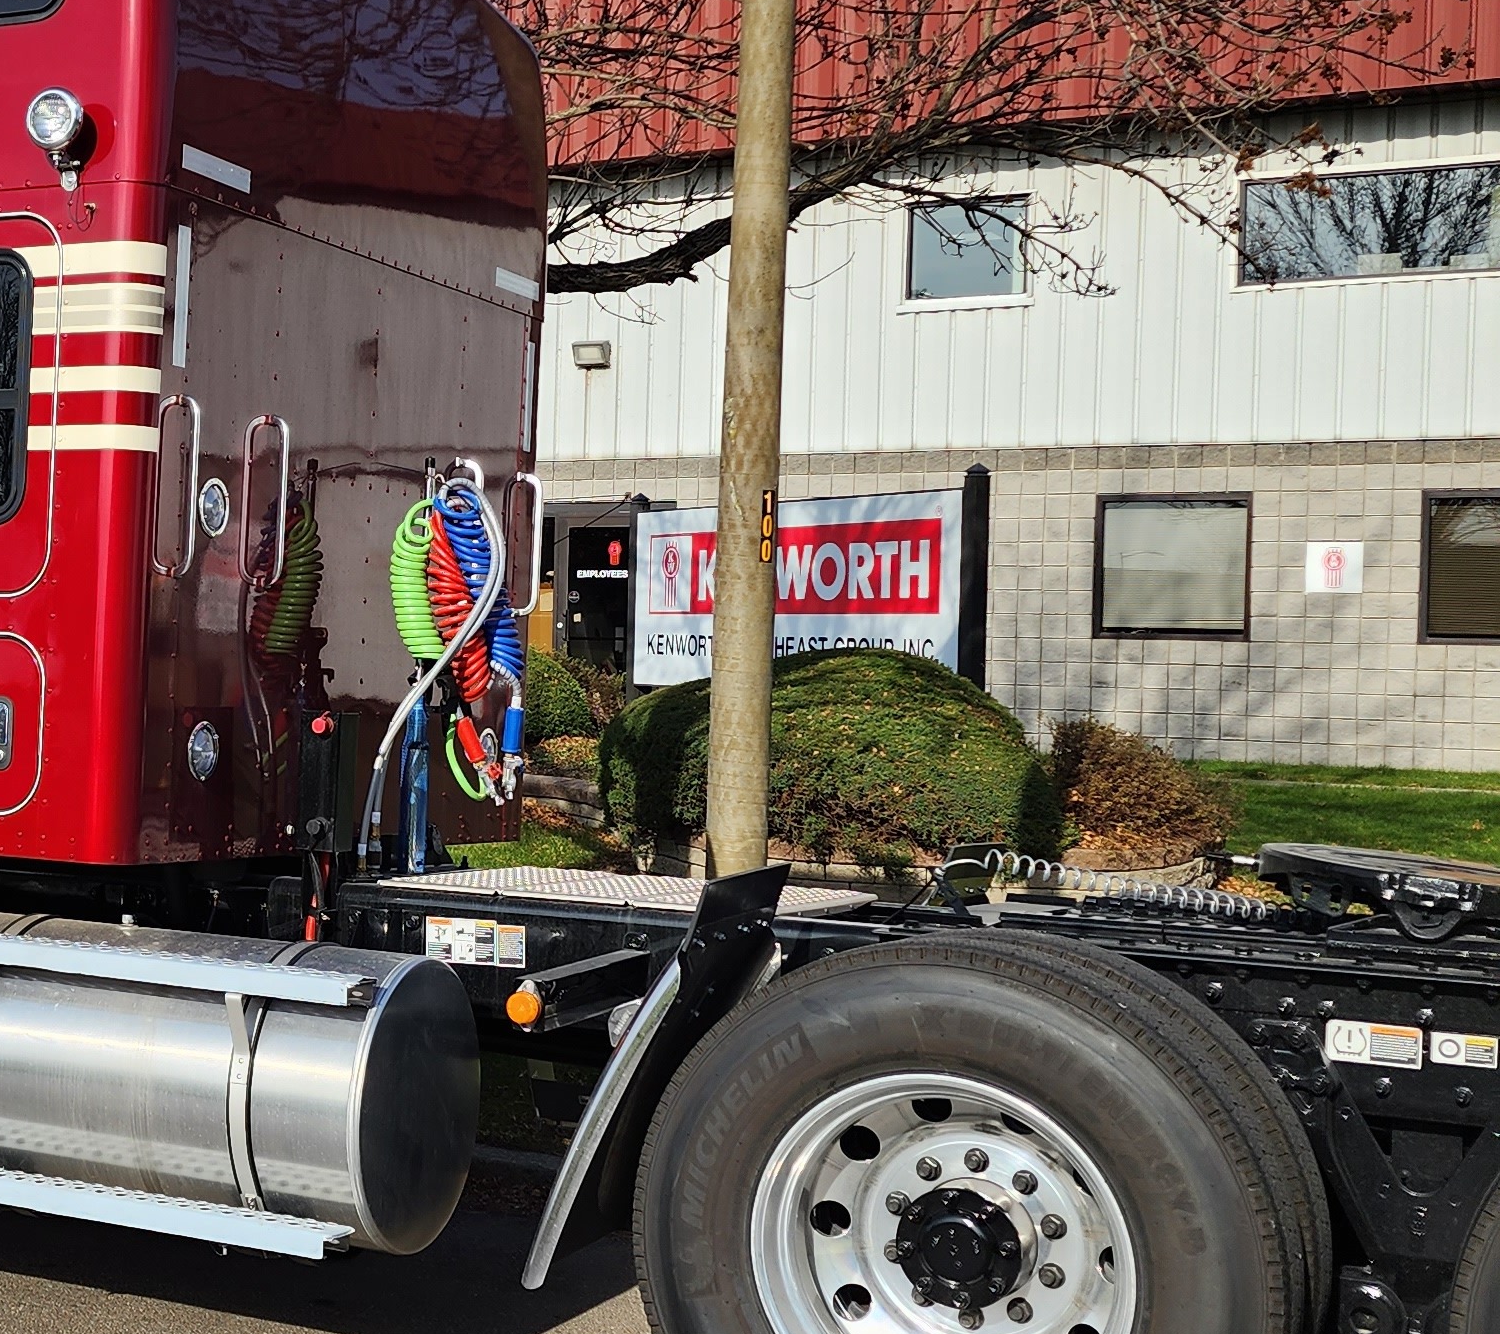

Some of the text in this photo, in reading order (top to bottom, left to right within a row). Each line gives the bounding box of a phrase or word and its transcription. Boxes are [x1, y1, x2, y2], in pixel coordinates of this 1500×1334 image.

[761, 491, 773, 562] 100
[577, 569, 629, 579] EMPLOYEES
[698, 539, 931, 601] KWORTH
[647, 634, 713, 657] KENWORT
[680, 1031, 802, 1230] MICHELIN
